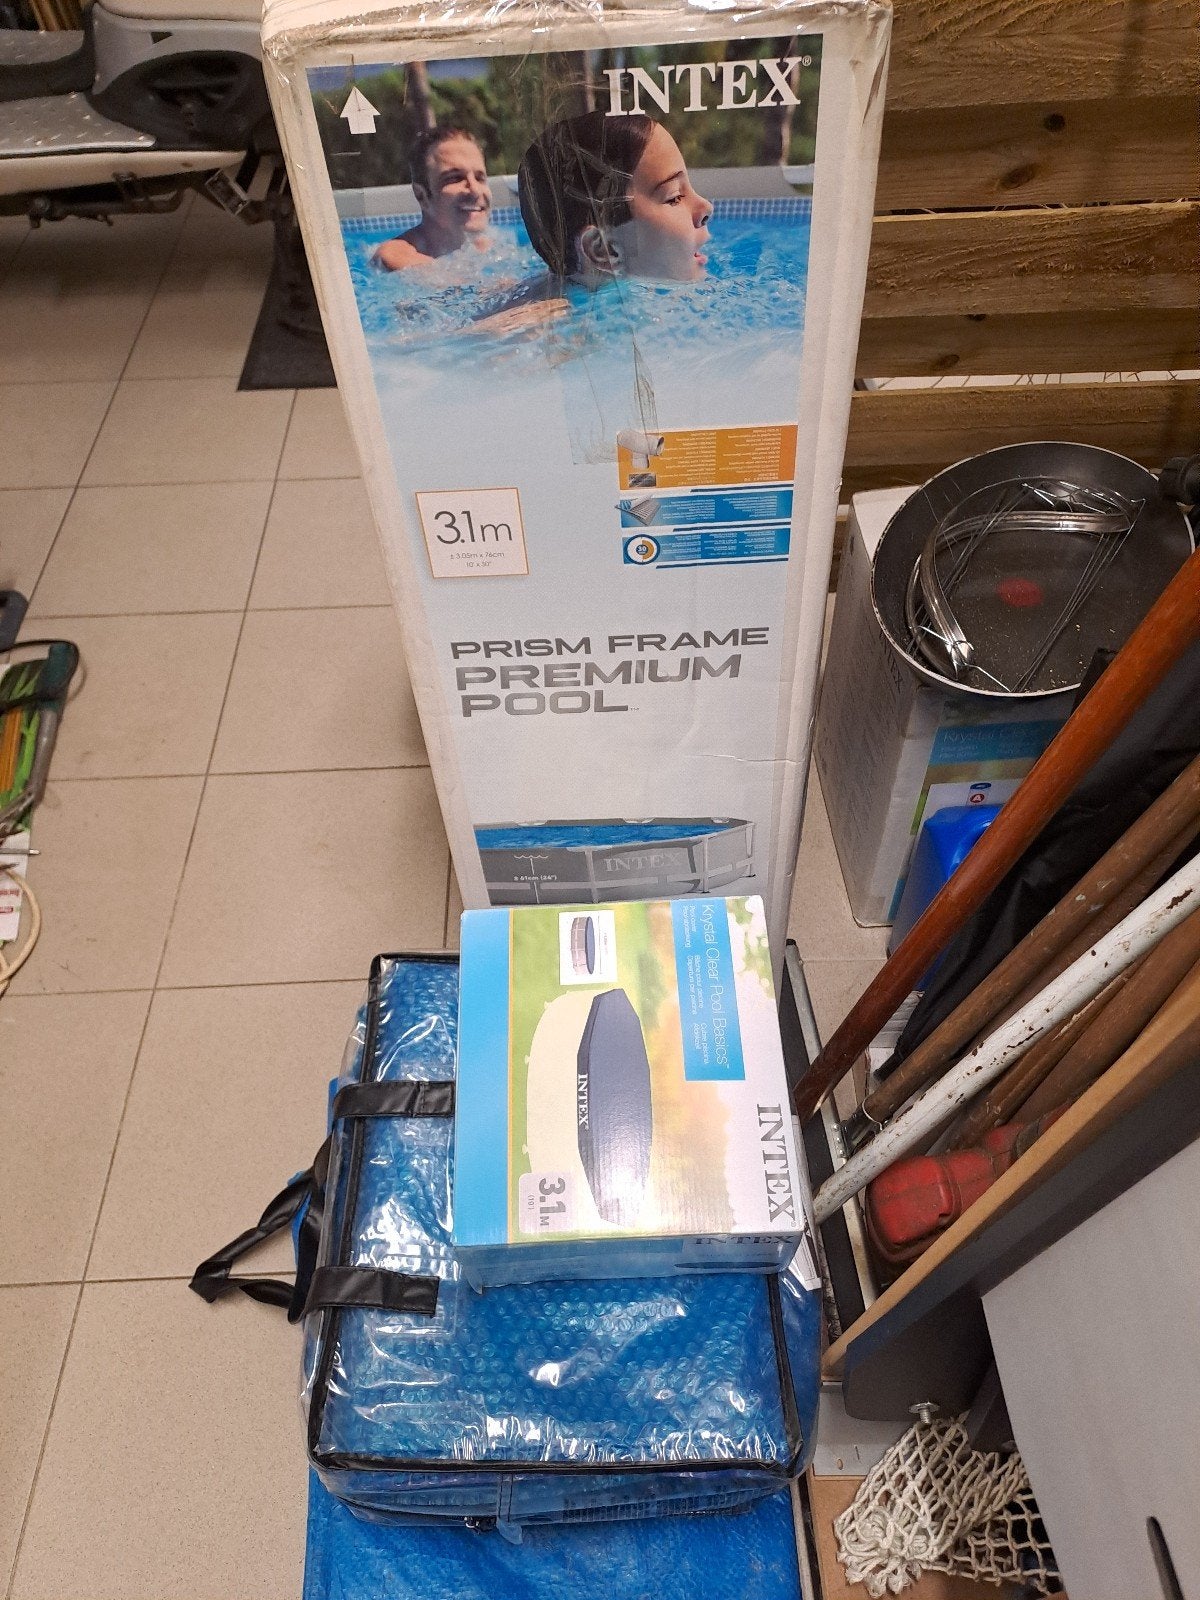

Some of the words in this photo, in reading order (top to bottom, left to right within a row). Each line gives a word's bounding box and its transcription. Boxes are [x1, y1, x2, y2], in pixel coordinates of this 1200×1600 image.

[602, 56, 802, 117] INTEX
[450, 636, 592, 660] PRISM
[608, 627, 770, 654] FRAME
[455, 653, 742, 691] PREMIUM
[461, 689, 629, 718] POOL
[604, 852, 681, 873] INTEX
[701, 904, 715, 945] Krystal
[705, 947, 720, 981] Clear
[710, 985, 724, 1015] Pool
[713, 1018, 728, 1066] Basics
[578, 1074, 589, 1126] INTEX
[757, 1104, 796, 1223] INTEX
